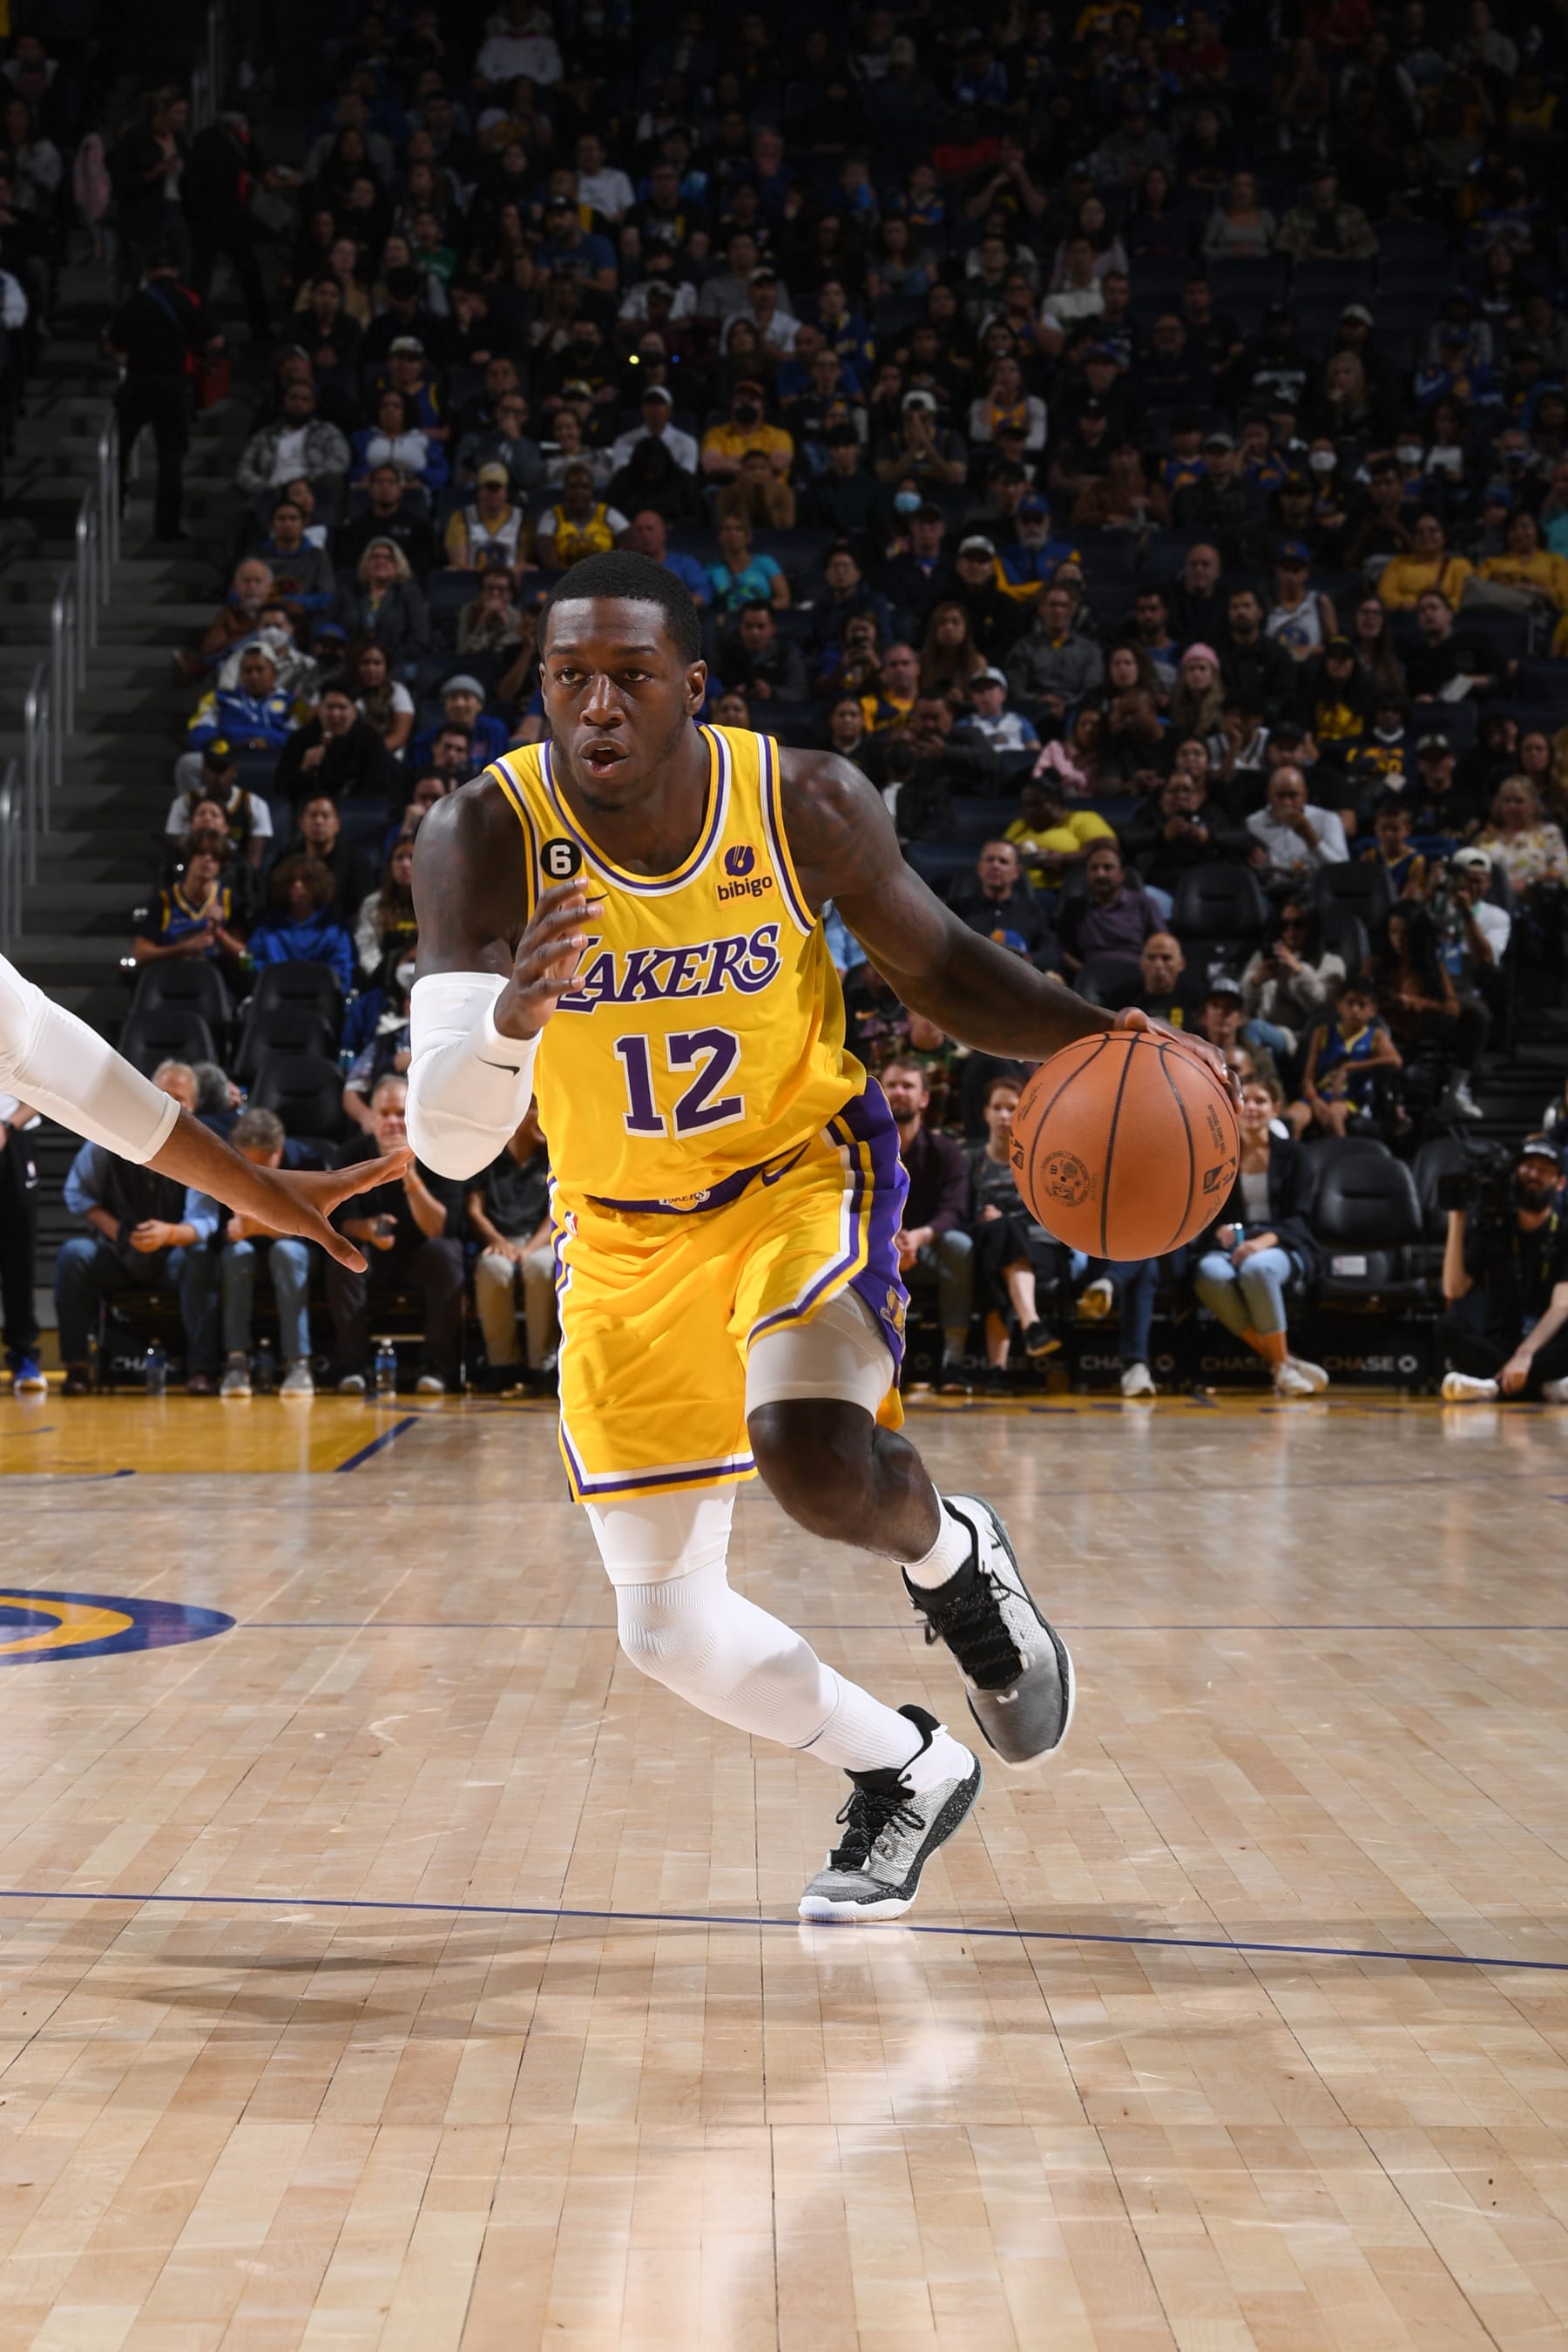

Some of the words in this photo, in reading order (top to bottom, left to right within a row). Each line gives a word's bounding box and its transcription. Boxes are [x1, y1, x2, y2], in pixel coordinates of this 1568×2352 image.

[550, 844, 571, 875] 6
[717, 875, 773, 901] bibigo
[613, 1025, 746, 1141] 12
[1322, 1355, 1394, 1372] CHASE
